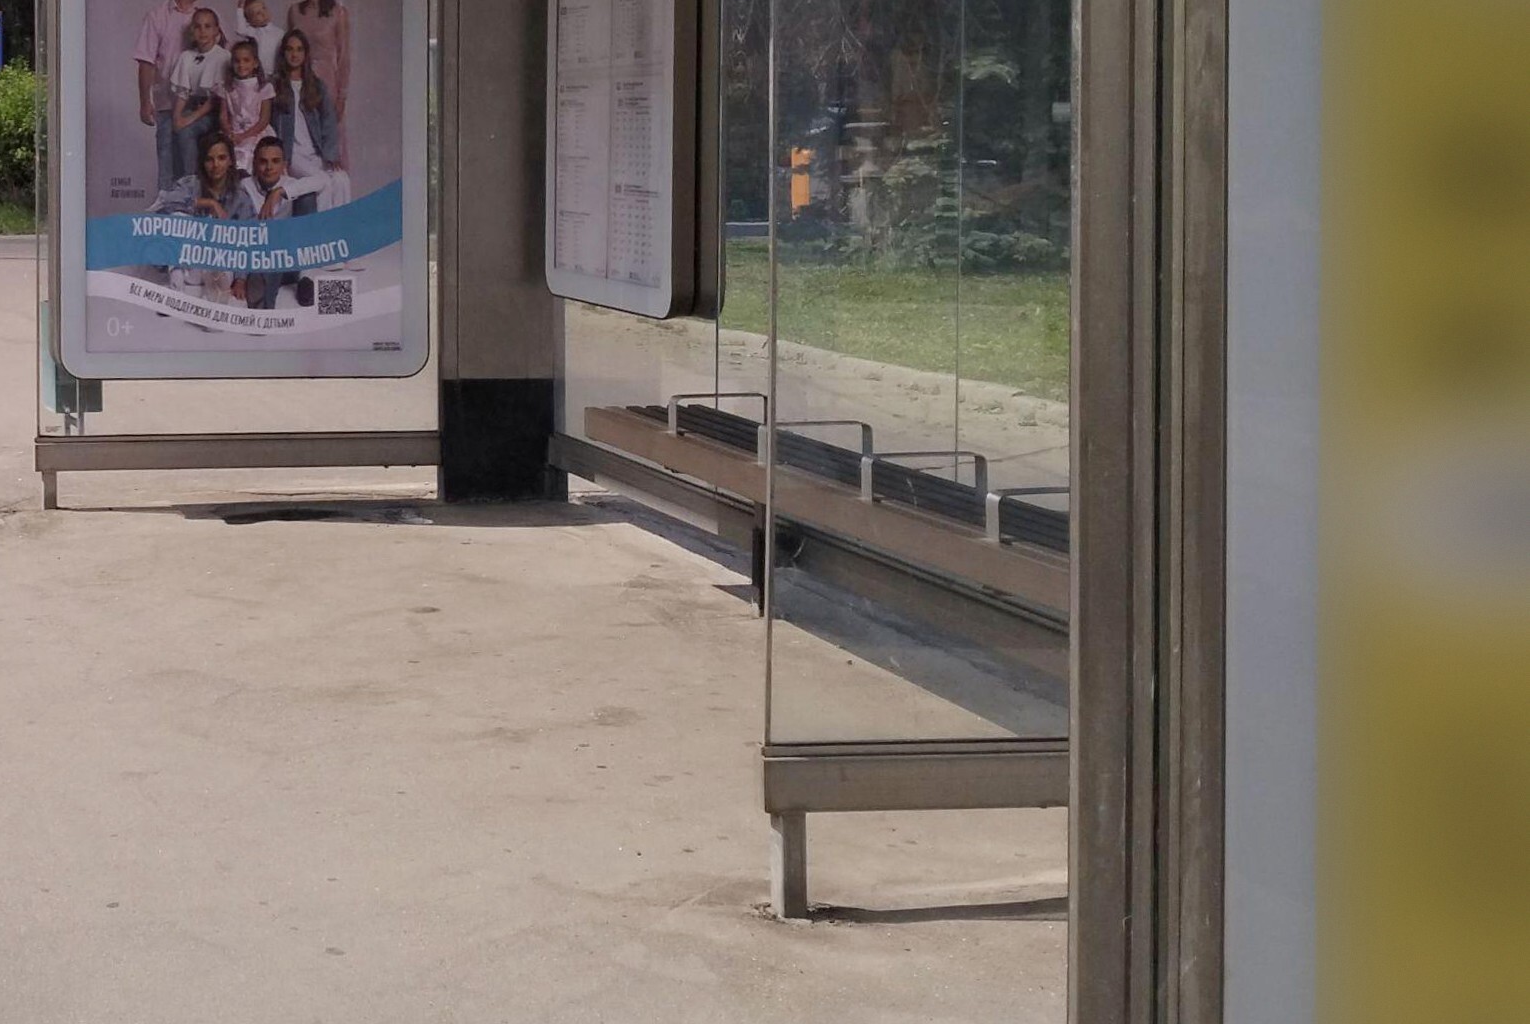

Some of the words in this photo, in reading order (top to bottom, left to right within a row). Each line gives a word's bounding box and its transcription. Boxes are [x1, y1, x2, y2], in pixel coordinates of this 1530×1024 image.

[132, 217, 208, 242] ХОРОШИХ
[210, 223, 269, 247] ЛЮДЕЙ
[179, 244, 248, 269] ДОЛЖНО
[251, 251, 294, 269] БЫТЬ
[297, 239, 350, 266] МНОГО
[129, 283, 143, 297] ВСЕ
[143, 288, 163, 304] МЕРЫ
[165, 295, 212, 319] ПОДДЕРЖКИ
[212, 310, 229, 323] ДЛЯ
[230, 314, 255, 327] СЕМЕЙ
[264, 318, 295, 329] ДЕТЬМИ
[107, 317, 134, 336] 0+
